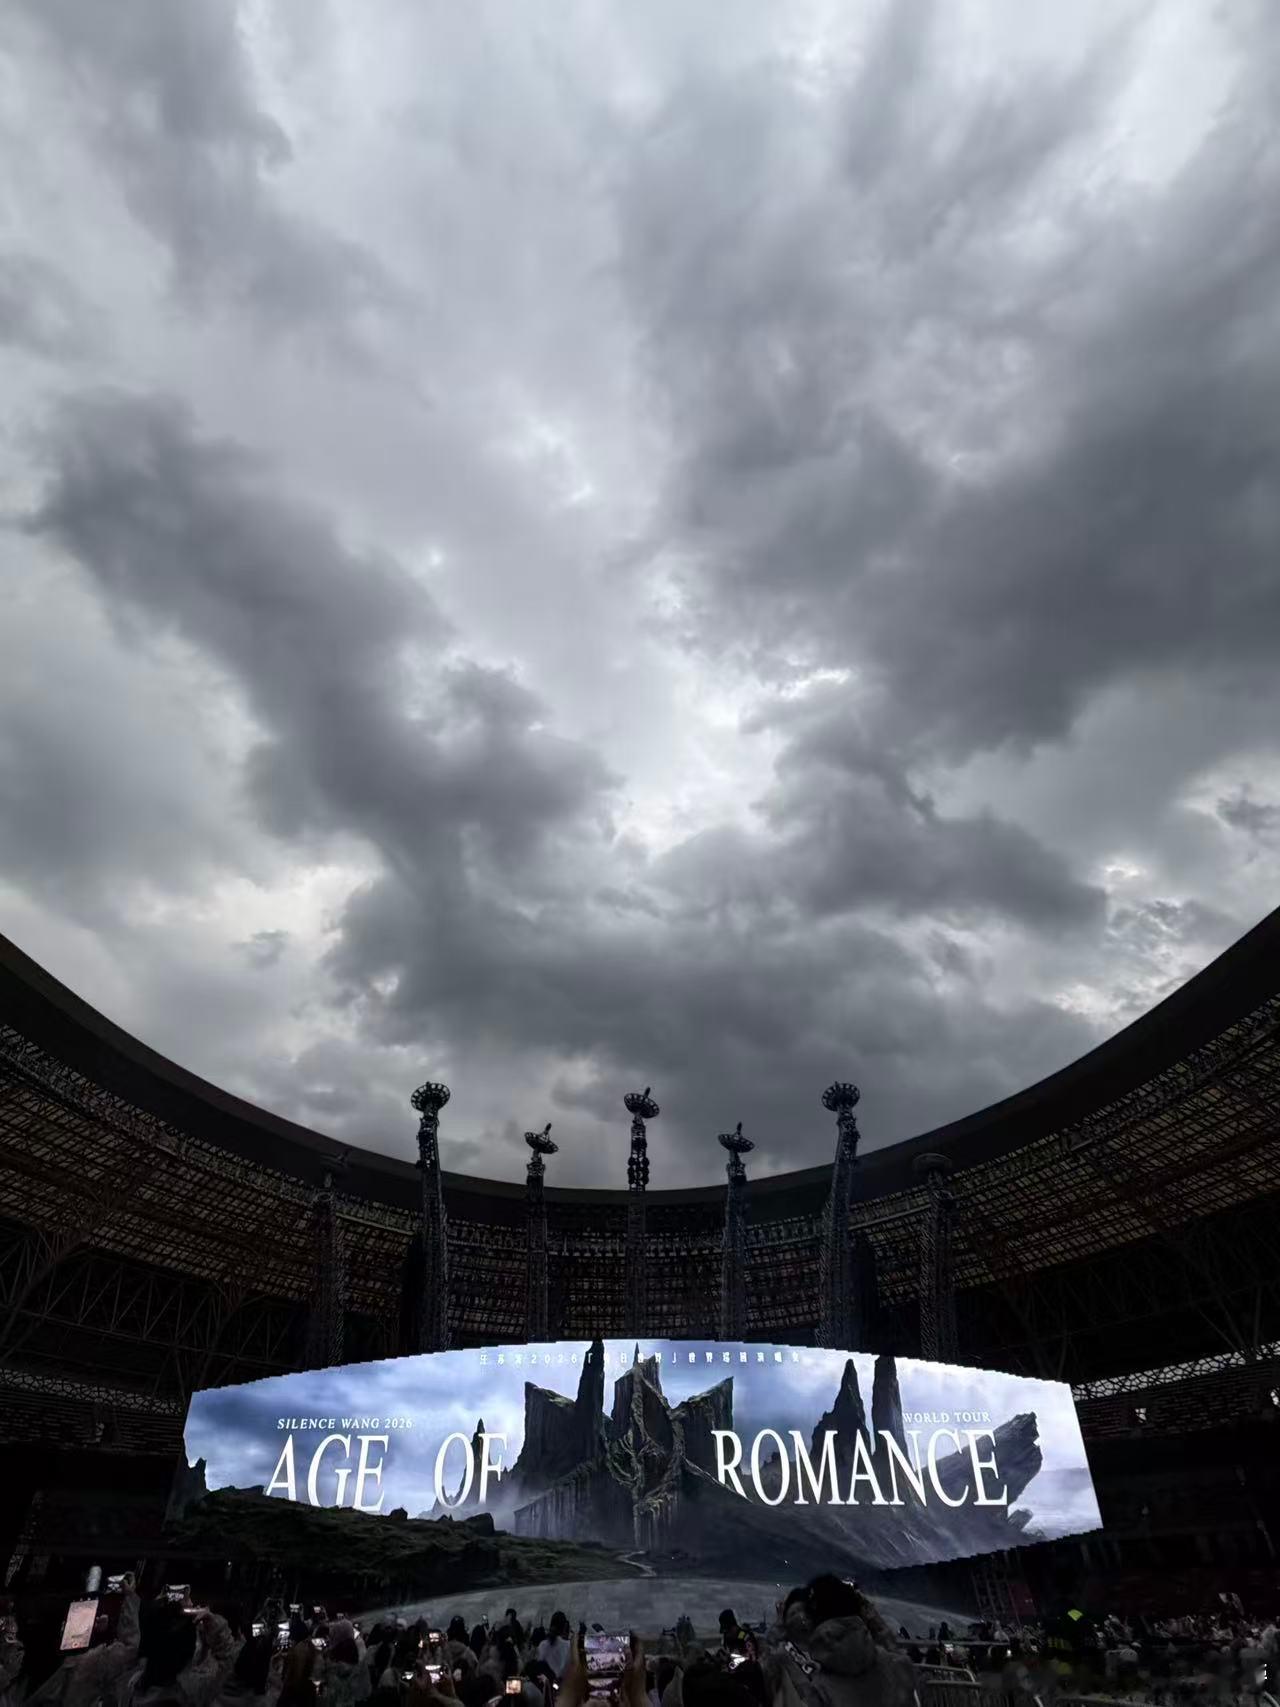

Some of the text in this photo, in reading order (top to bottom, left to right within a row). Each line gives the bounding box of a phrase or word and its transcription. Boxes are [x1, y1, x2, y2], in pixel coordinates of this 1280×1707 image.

[902, 1411, 991, 1423] WORLD TOUR
[277, 1418, 413, 1430] SILENCE WANG 2026
[265, 1429, 1007, 1512] AGE OF ROMANCE
